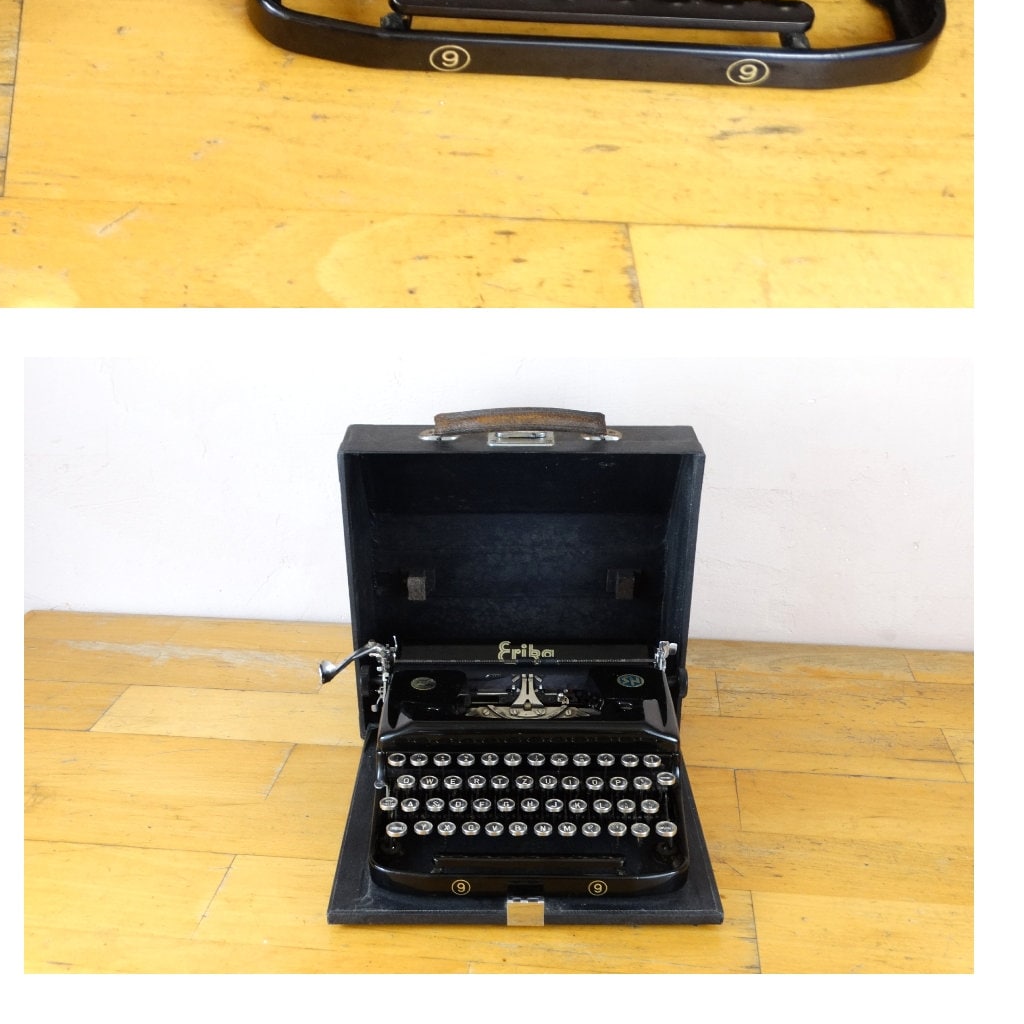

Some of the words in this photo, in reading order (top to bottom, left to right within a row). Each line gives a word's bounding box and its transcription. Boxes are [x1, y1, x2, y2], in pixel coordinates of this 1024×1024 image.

[441, 50, 459, 67] 9
[739, 64, 757, 80] 9
[497, 640, 555, 660] Erika
[457, 882, 466, 893] 9
[593, 883, 603, 893] 9
